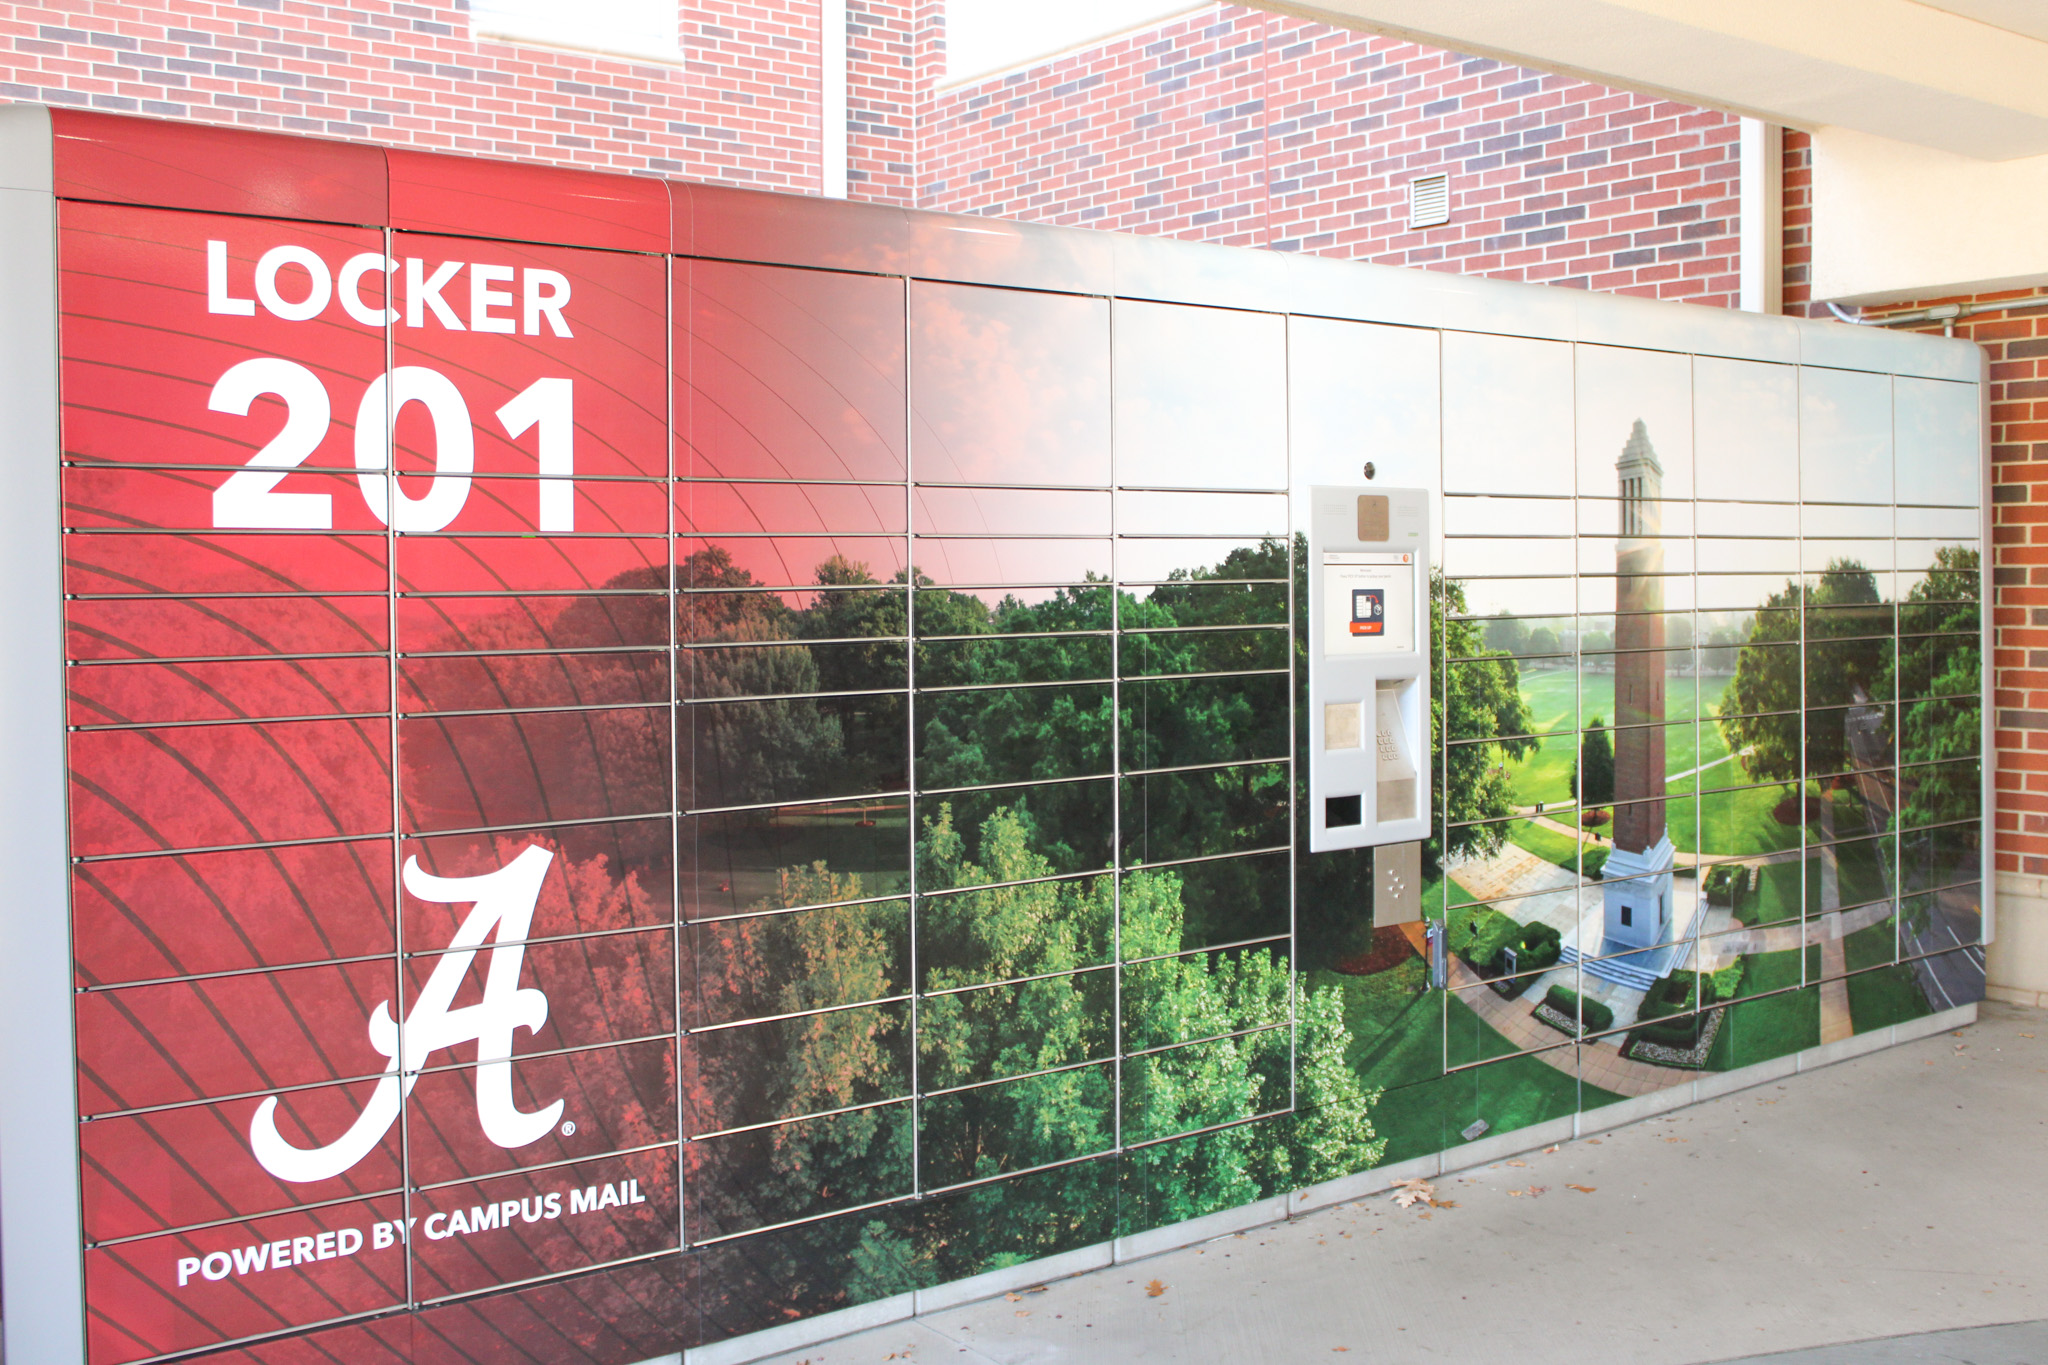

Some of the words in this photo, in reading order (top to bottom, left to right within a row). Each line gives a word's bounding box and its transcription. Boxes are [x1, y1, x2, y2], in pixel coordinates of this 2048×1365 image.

[207, 239, 574, 339] LOCKER
[207, 357, 574, 532] 201
[178, 1229, 363, 1287] POWERED
[373, 1217, 418, 1250] BY
[424, 1193, 562, 1240] CAMPUS
[570, 1179, 645, 1215] MAIL
